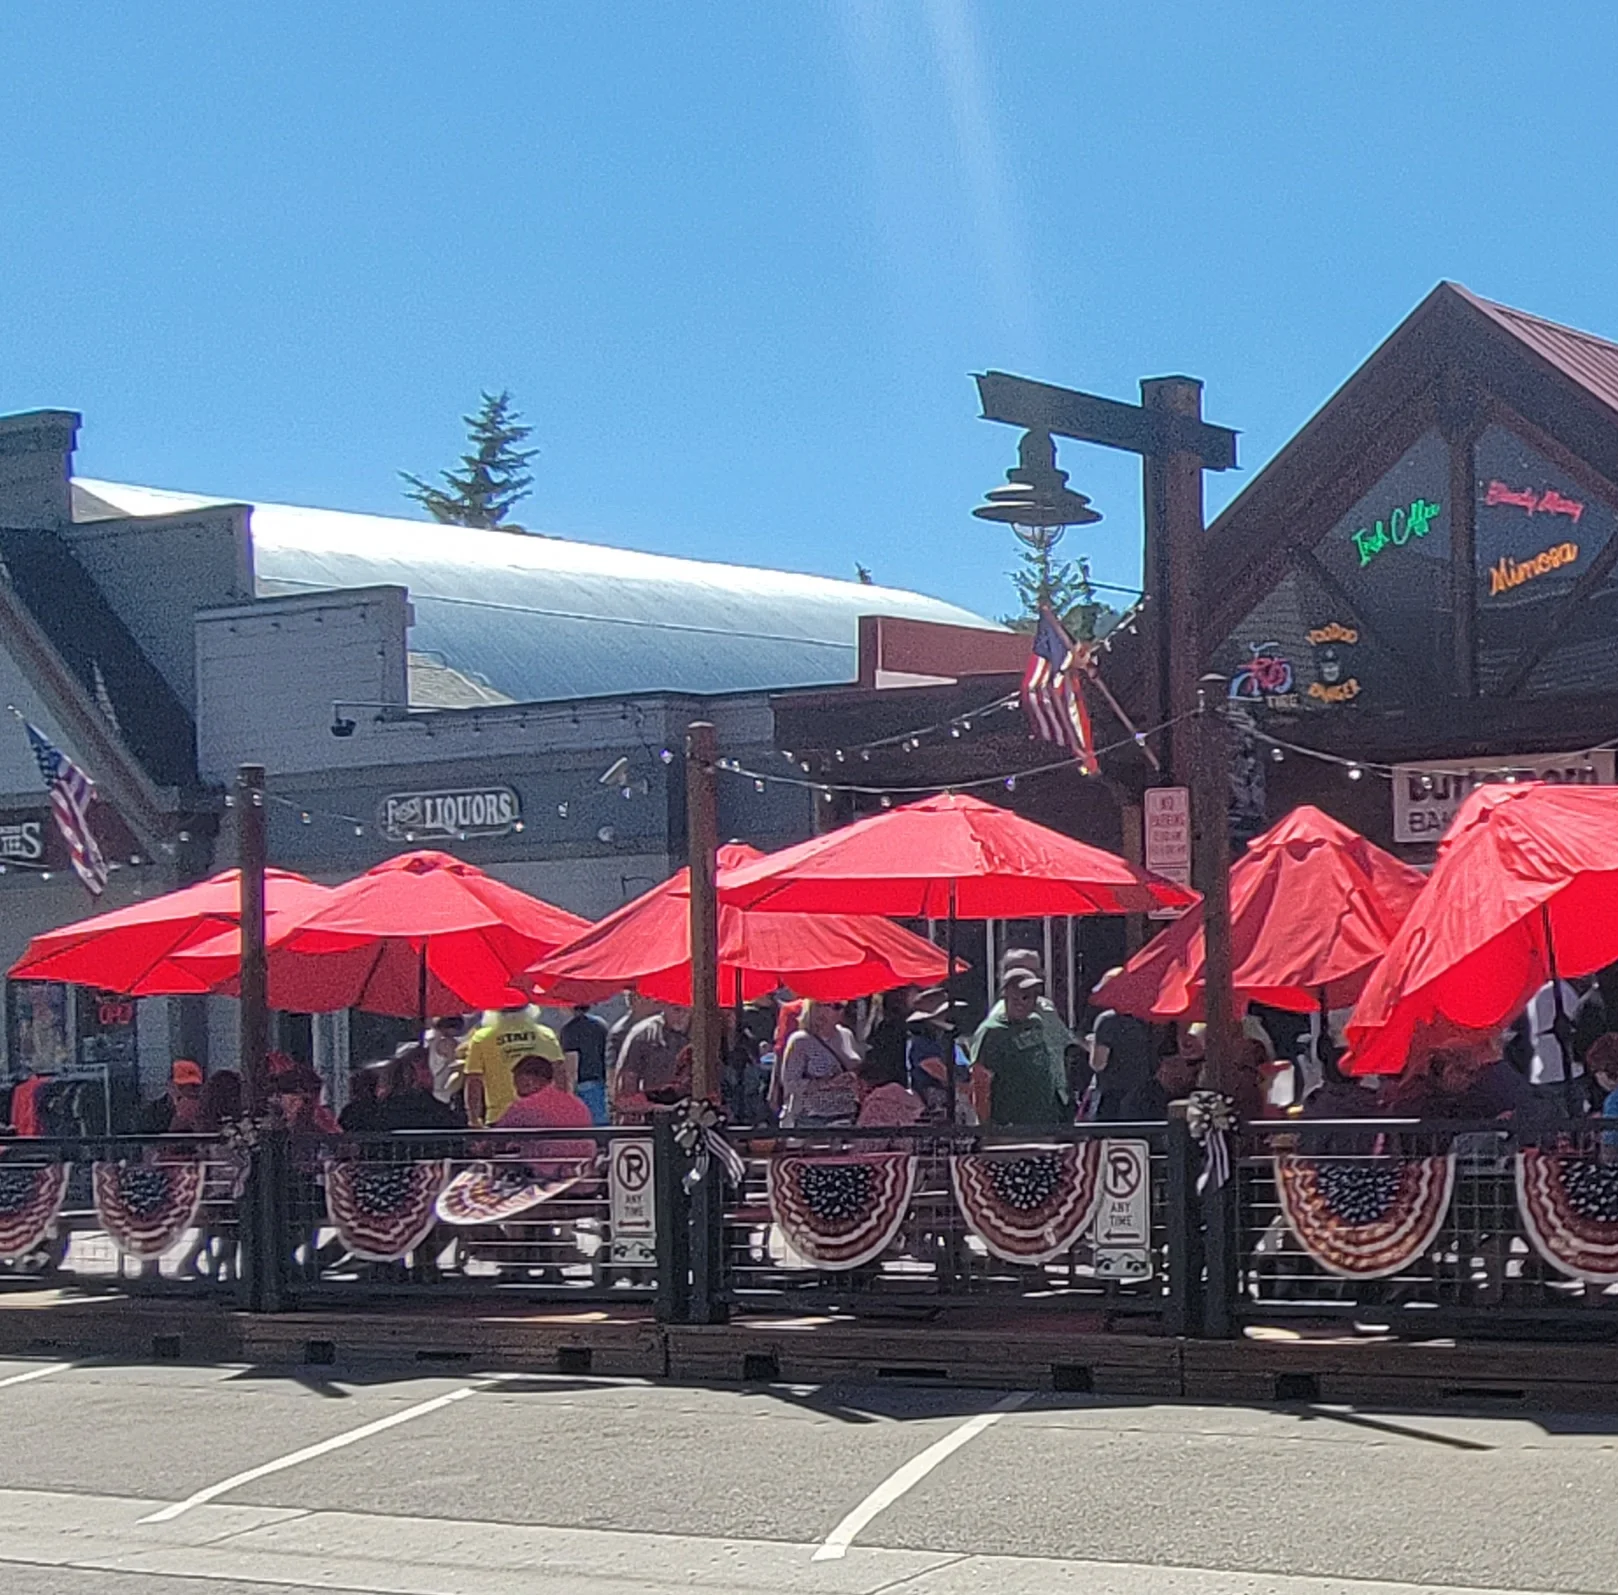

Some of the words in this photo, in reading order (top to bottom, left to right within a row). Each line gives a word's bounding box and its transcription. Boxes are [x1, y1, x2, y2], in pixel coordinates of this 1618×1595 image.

[1390, 498, 1441, 546] Coffee
[1488, 542, 1580, 596] Mimosa
[423, 793, 513, 834] LIQUORS
[625, 1194, 644, 1204] ANY
[623, 1205, 645, 1217] TIME
[1110, 1202, 1131, 1213] ANY
[1108, 1214, 1133, 1227] TIME
